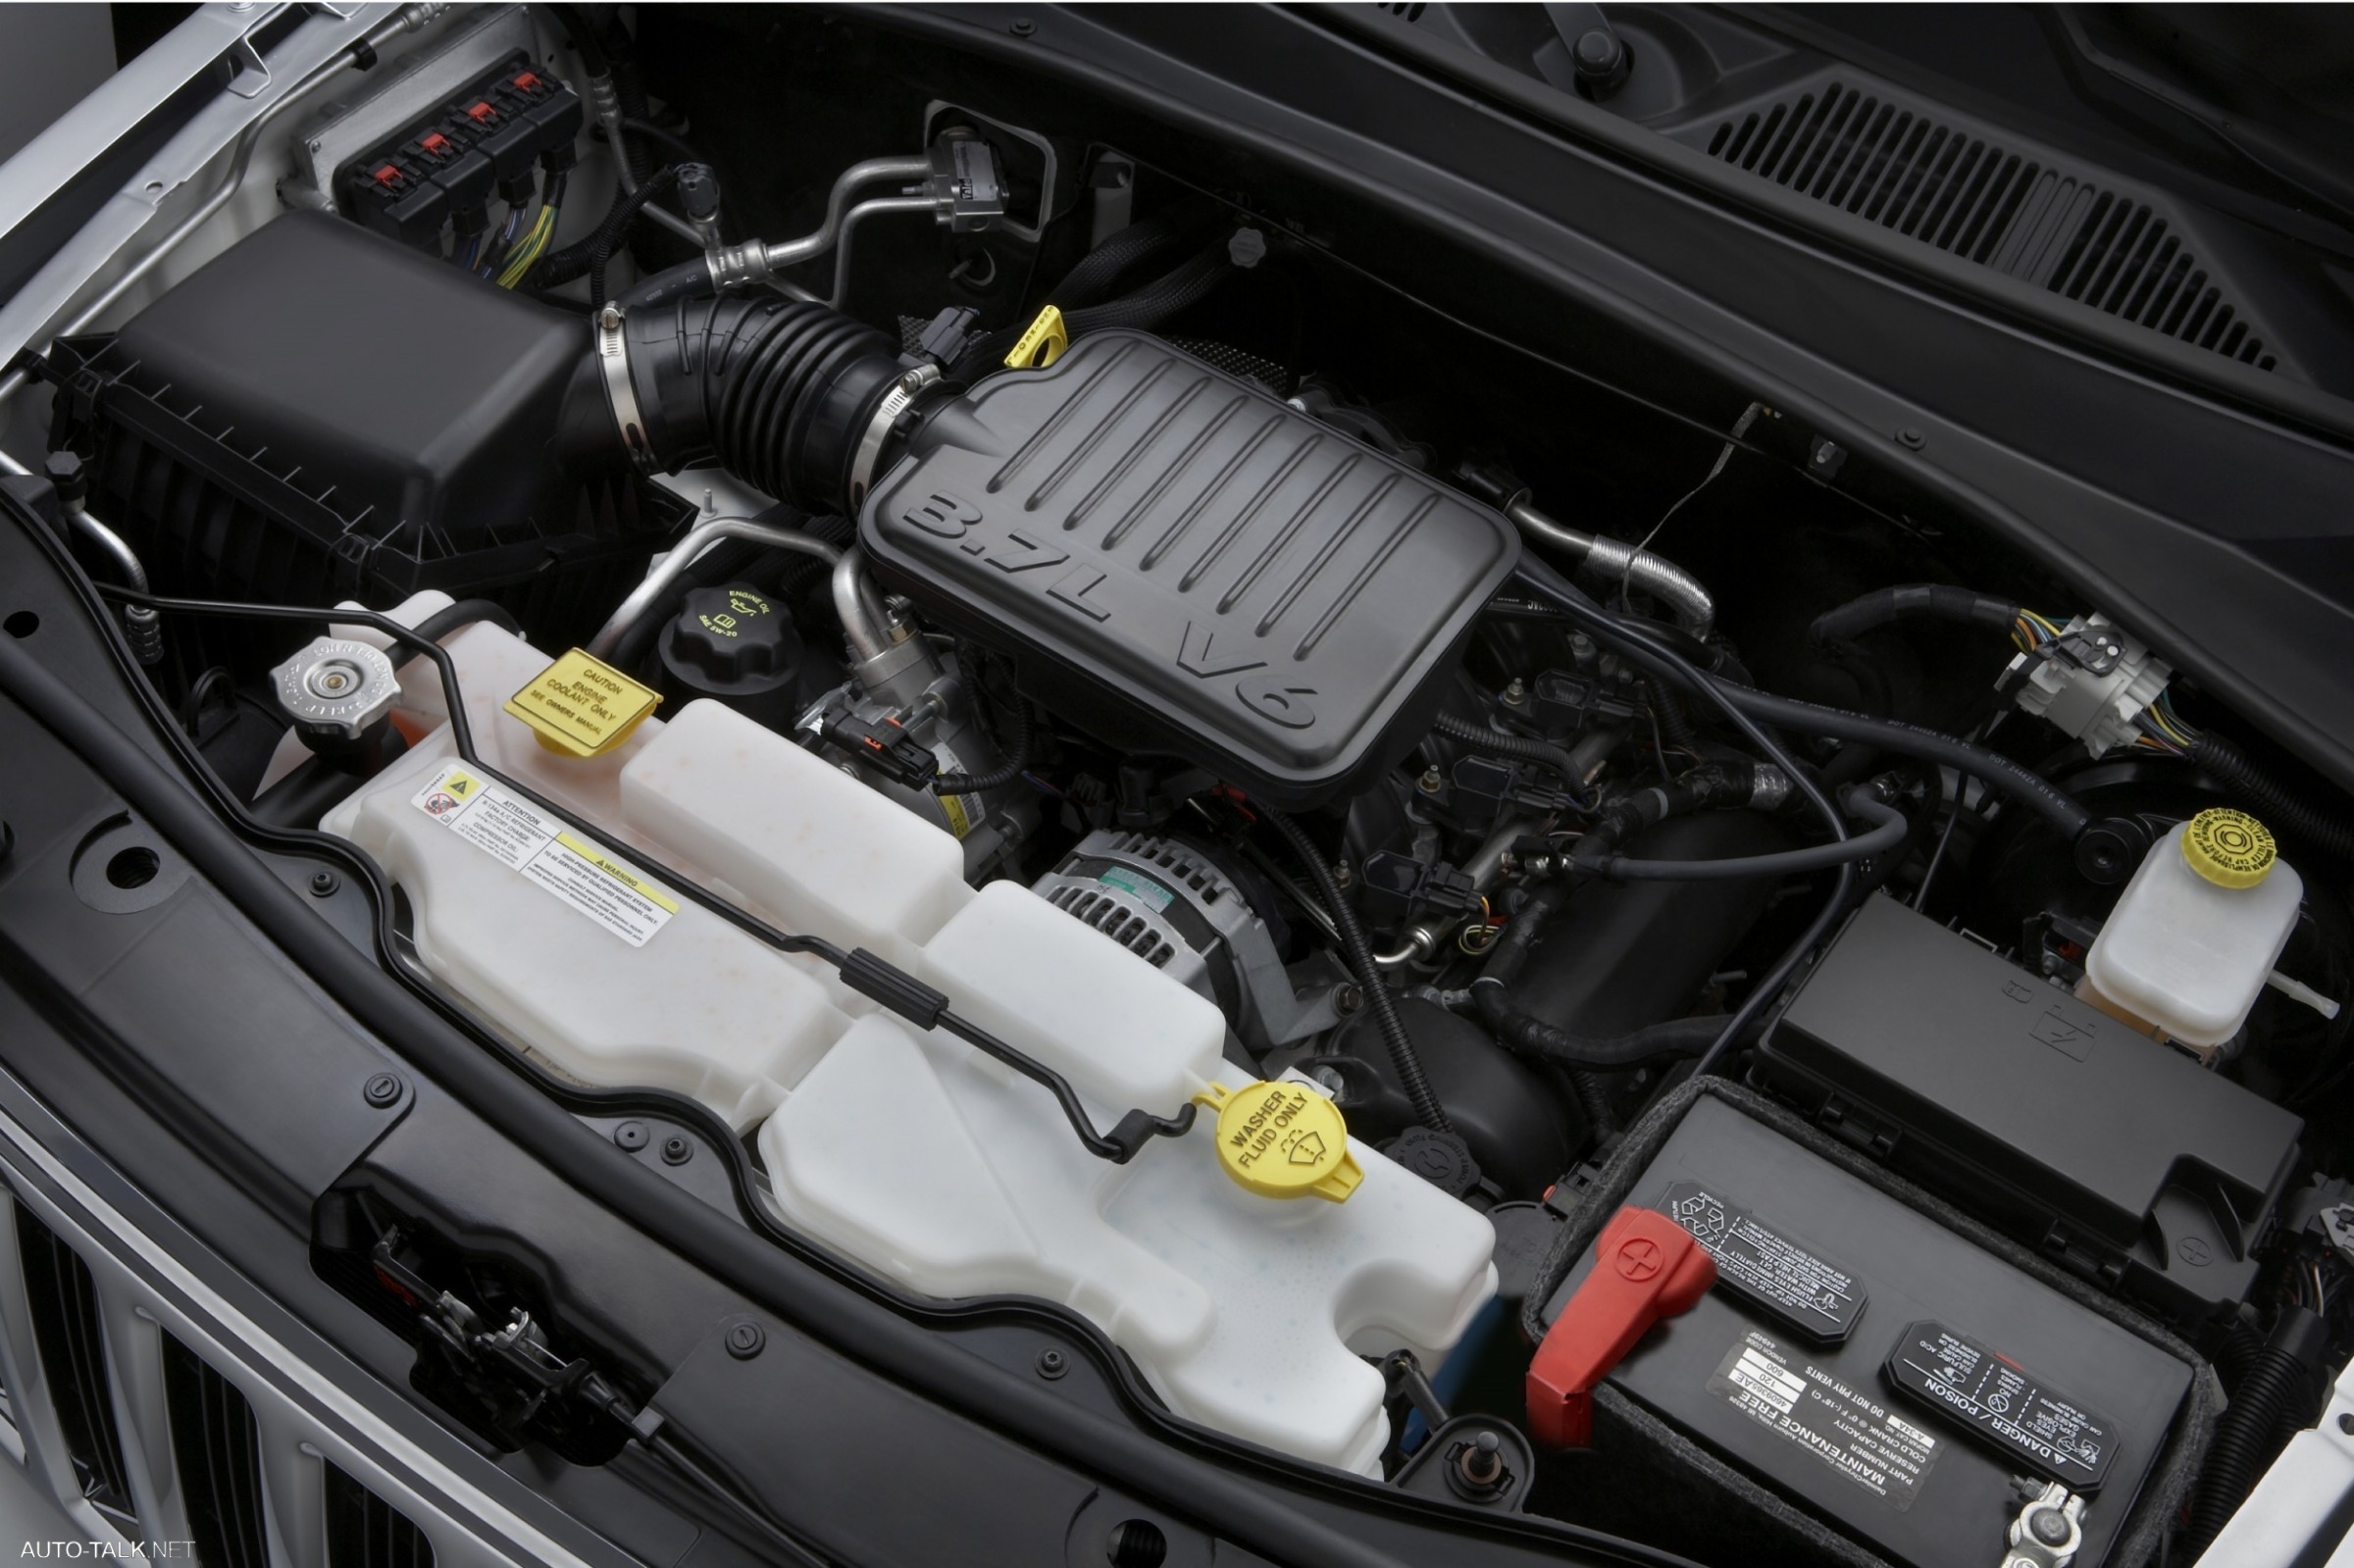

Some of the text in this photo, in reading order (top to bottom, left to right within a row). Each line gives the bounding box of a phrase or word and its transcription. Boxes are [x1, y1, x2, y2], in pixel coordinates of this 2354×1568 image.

[729, 590, 769, 613] ENGINE OIL
[903, 493, 1322, 731] 3.7L V6
[698, 614, 737, 636] SAE 5W-20
[571, 681, 607, 704] ENGINE
[582, 668, 623, 694] CAUTION
[530, 688, 602, 734] SEE OWNERS MANUAL
[545, 679, 617, 722] COOLANT ONLY
[1987, 752, 2007, 768] DOT
[2055, 797, 2067, 810] VL
[484, 811, 508, 827] FACTORY
[502, 800, 540, 825] ATTENTION
[472, 822, 508, 845] COMPRESSOR
[507, 843, 518, 852] OIL:
[499, 811, 511, 820] A/C
[510, 818, 545, 841] REFRIGERANT
[560, 851, 653, 912] HIGH-PRESSURE REFRIGERANT SYSTEM
[602, 863, 639, 886] WARNING
[556, 858, 583, 877] SERVICED
[587, 878, 615, 897] QUALIFIED
[613, 894, 644, 916] PERSONNEL
[1229, 1088, 1287, 1146] WASHER
[1236, 1090, 1307, 1169] FLUID ONLY
[1697, 1189, 1724, 1209] RECYCLE
[1728, 1248, 1814, 1301] FLUSH EYES IMMEDIATELY
[1755, 1248, 1820, 1290] MEDICAL HELP FAST
[1759, 1258, 1773, 1270] GET
[1798, 1281, 1817, 1295] WITH
[1744, 1336, 1788, 1365] VENDOR CODE
[1937, 1337, 1978, 1363] BLINDNESS OR
[1939, 1332, 1981, 1358] SEVERE BURNS
[1941, 1345, 1975, 1368] CAN CAUSE
[1918, 1339, 1972, 1375] SULFURIC ACID
[1757, 1372, 1777, 1388] 120
[1765, 1361, 1784, 1378] 600
[1999, 1366, 2025, 1385] SMOKING
[1733, 1371, 1788, 1408] 4609365AE
[1804, 1364, 1884, 1418] DO NOT PRY VENTS
[1995, 1378, 2020, 1394] SPARKS
[1998, 1386, 2012, 1398] NO
[1999, 1373, 2022, 1390] FLAMES
[1809, 1388, 1822, 1401] C)
[1747, 1406, 1757, 1416] MI
[1840, 1406, 1849, 1417] F
[1922, 1377, 2052, 1458] DANGER / POISON
[2038, 1396, 2071, 1418] BLINDNESS
[2056, 1399, 2086, 1420] OR INJURY
[1771, 1422, 1797, 1441] Auburn
[1857, 1416, 1869, 1429] @
[1896, 1420, 1925, 1442] A-34A
[2024, 1419, 2054, 1440] SHIELD
[2034, 1409, 2077, 1438] EXPLOSIVE
[2035, 1417, 2057, 1434] EYES
[2053, 1412, 2080, 1432] GASES
[2070, 1414, 2089, 1429] CAUSE
[1737, 1389, 1886, 1486] MAINTENANCE FREE
[1832, 1417, 1920, 1474] RESERVE CAPACITY
[1868, 1423, 1902, 1448] CRANK
[1908, 1437, 1931, 1454] MOPAR
[1796, 1437, 1835, 1464] Corporation
[1899, 1442, 1927, 1463] COLD
[1849, 1442, 1914, 1485] PART NUMBER
[1834, 1460, 1887, 1495] DaimlerChrysler
